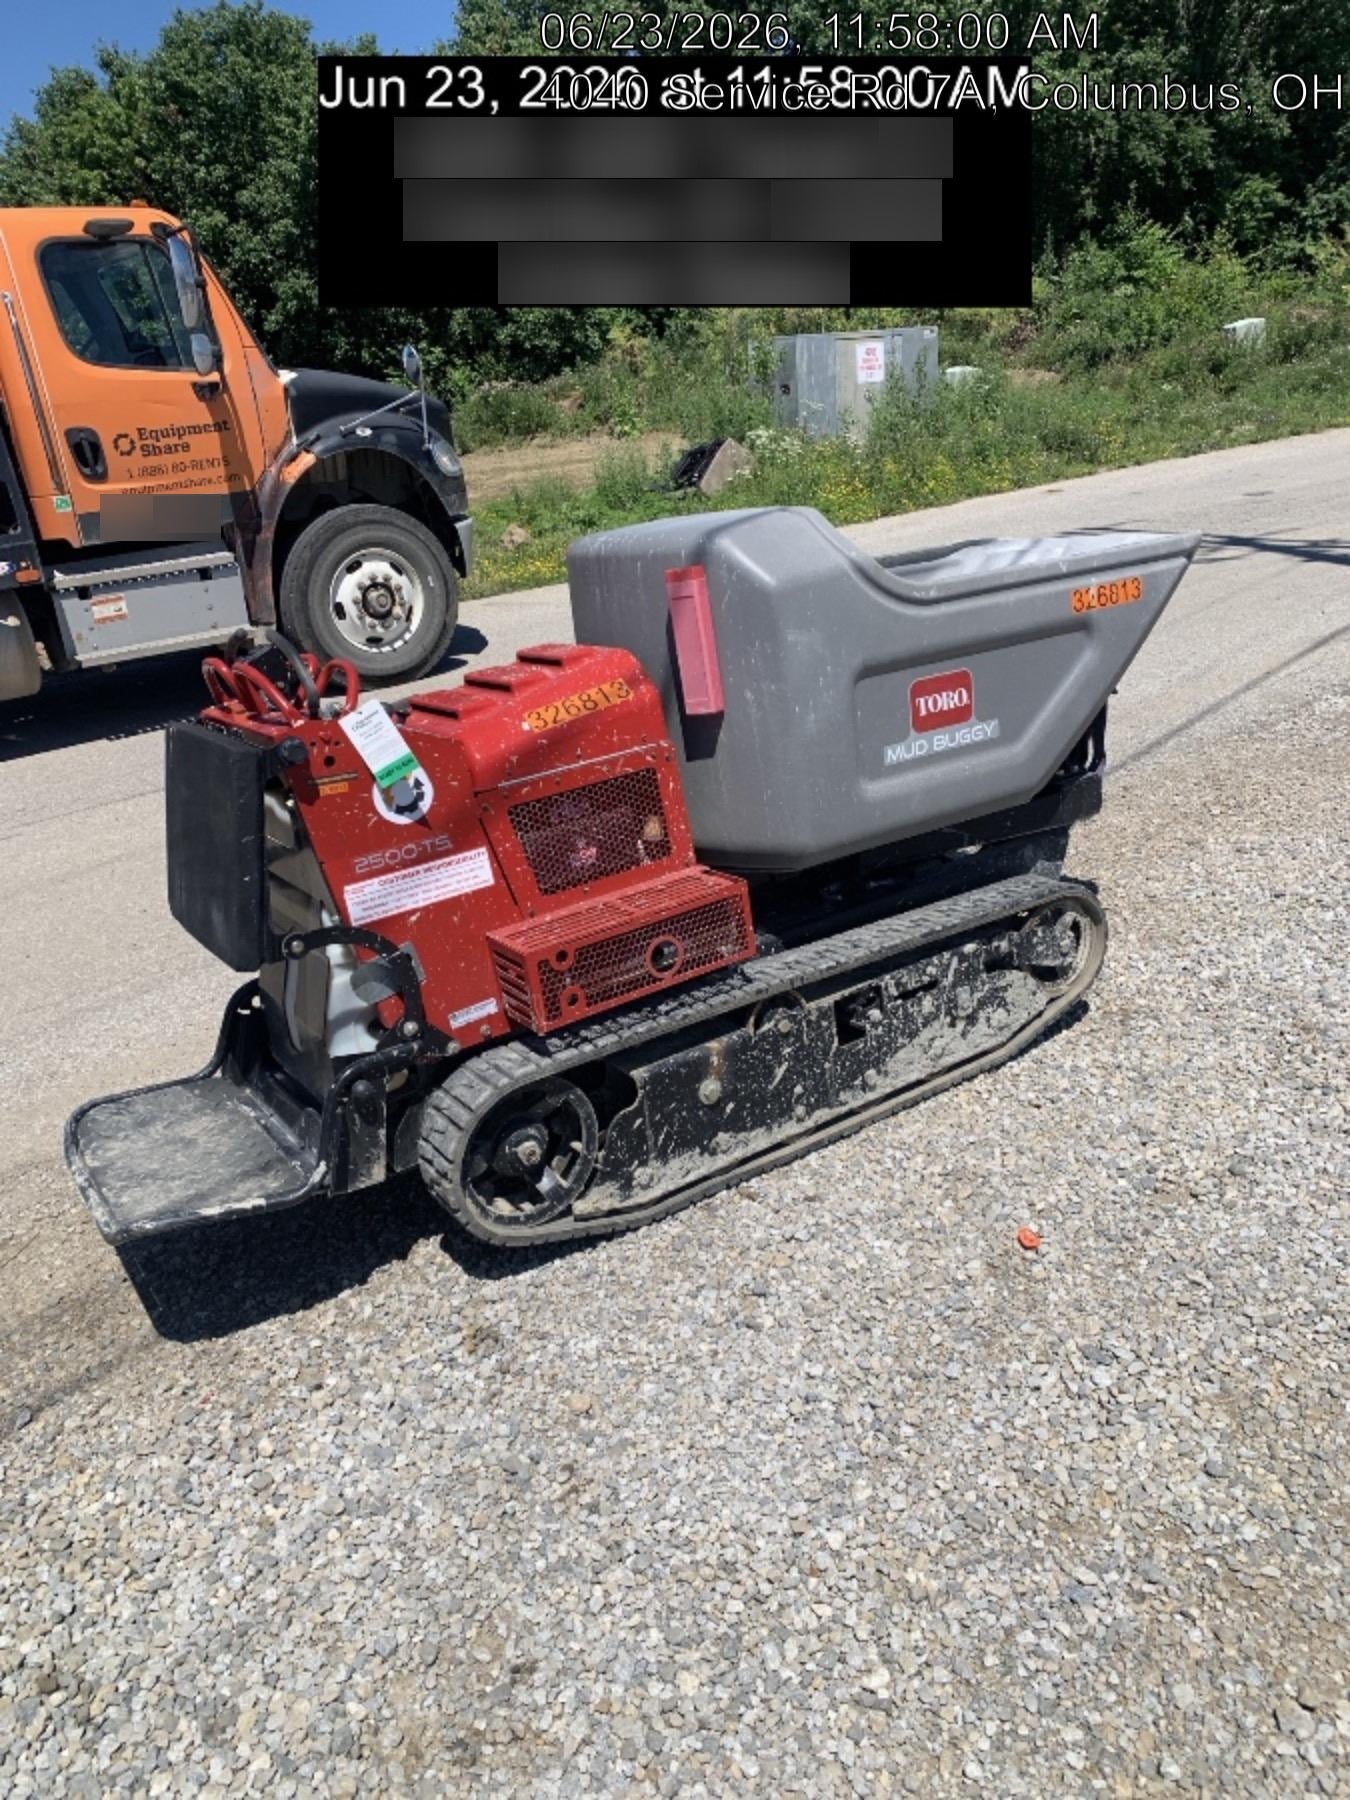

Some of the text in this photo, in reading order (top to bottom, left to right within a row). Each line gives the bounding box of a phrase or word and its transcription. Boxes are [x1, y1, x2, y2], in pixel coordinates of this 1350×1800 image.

[136, 419, 231, 442] Equipment
[140, 441, 191, 457] Share
[1072, 577, 1142, 613] 326813
[527, 680, 632, 731] 326813
[915, 688, 970, 717] TORO
[886, 721, 998, 763] MUD BUGGY
